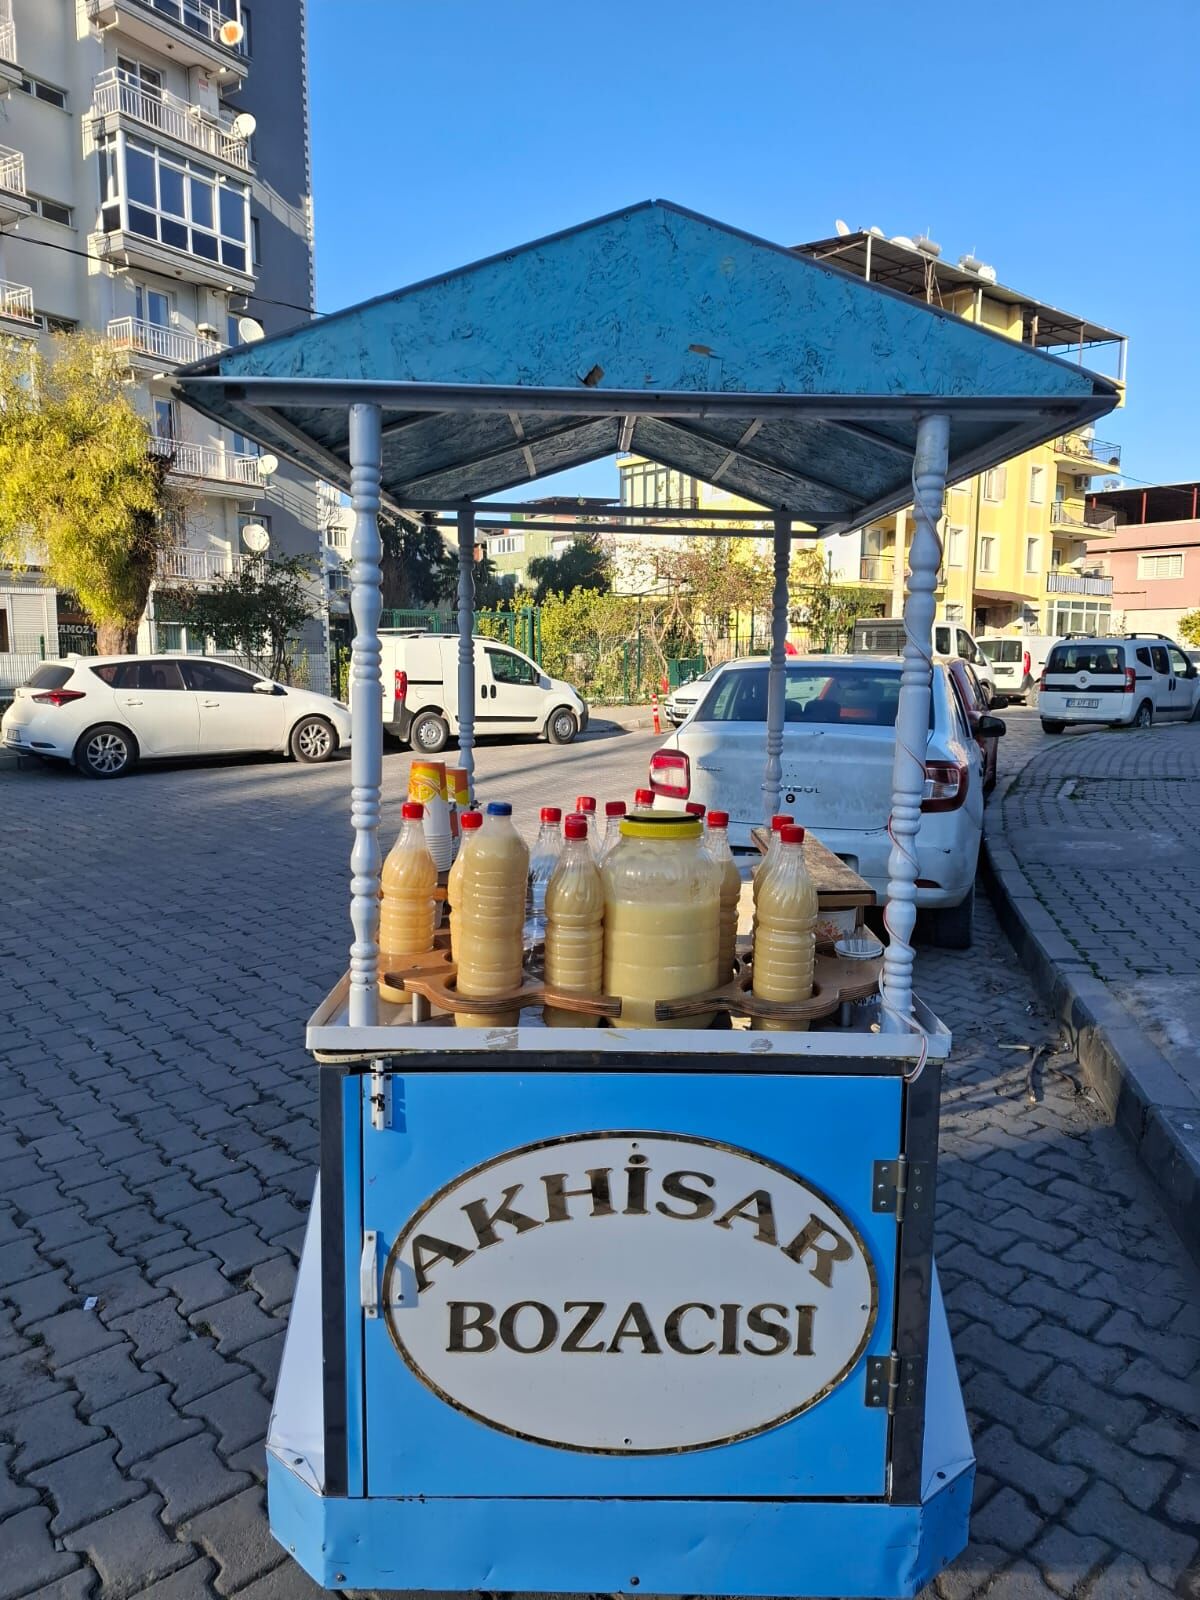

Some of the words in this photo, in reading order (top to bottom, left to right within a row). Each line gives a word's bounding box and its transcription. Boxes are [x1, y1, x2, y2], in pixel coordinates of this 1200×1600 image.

[760, 783, 821, 793] SMBOL
[410, 1154, 855, 1293] AKHİSAR
[445, 1300, 818, 1356] BOZACISI
